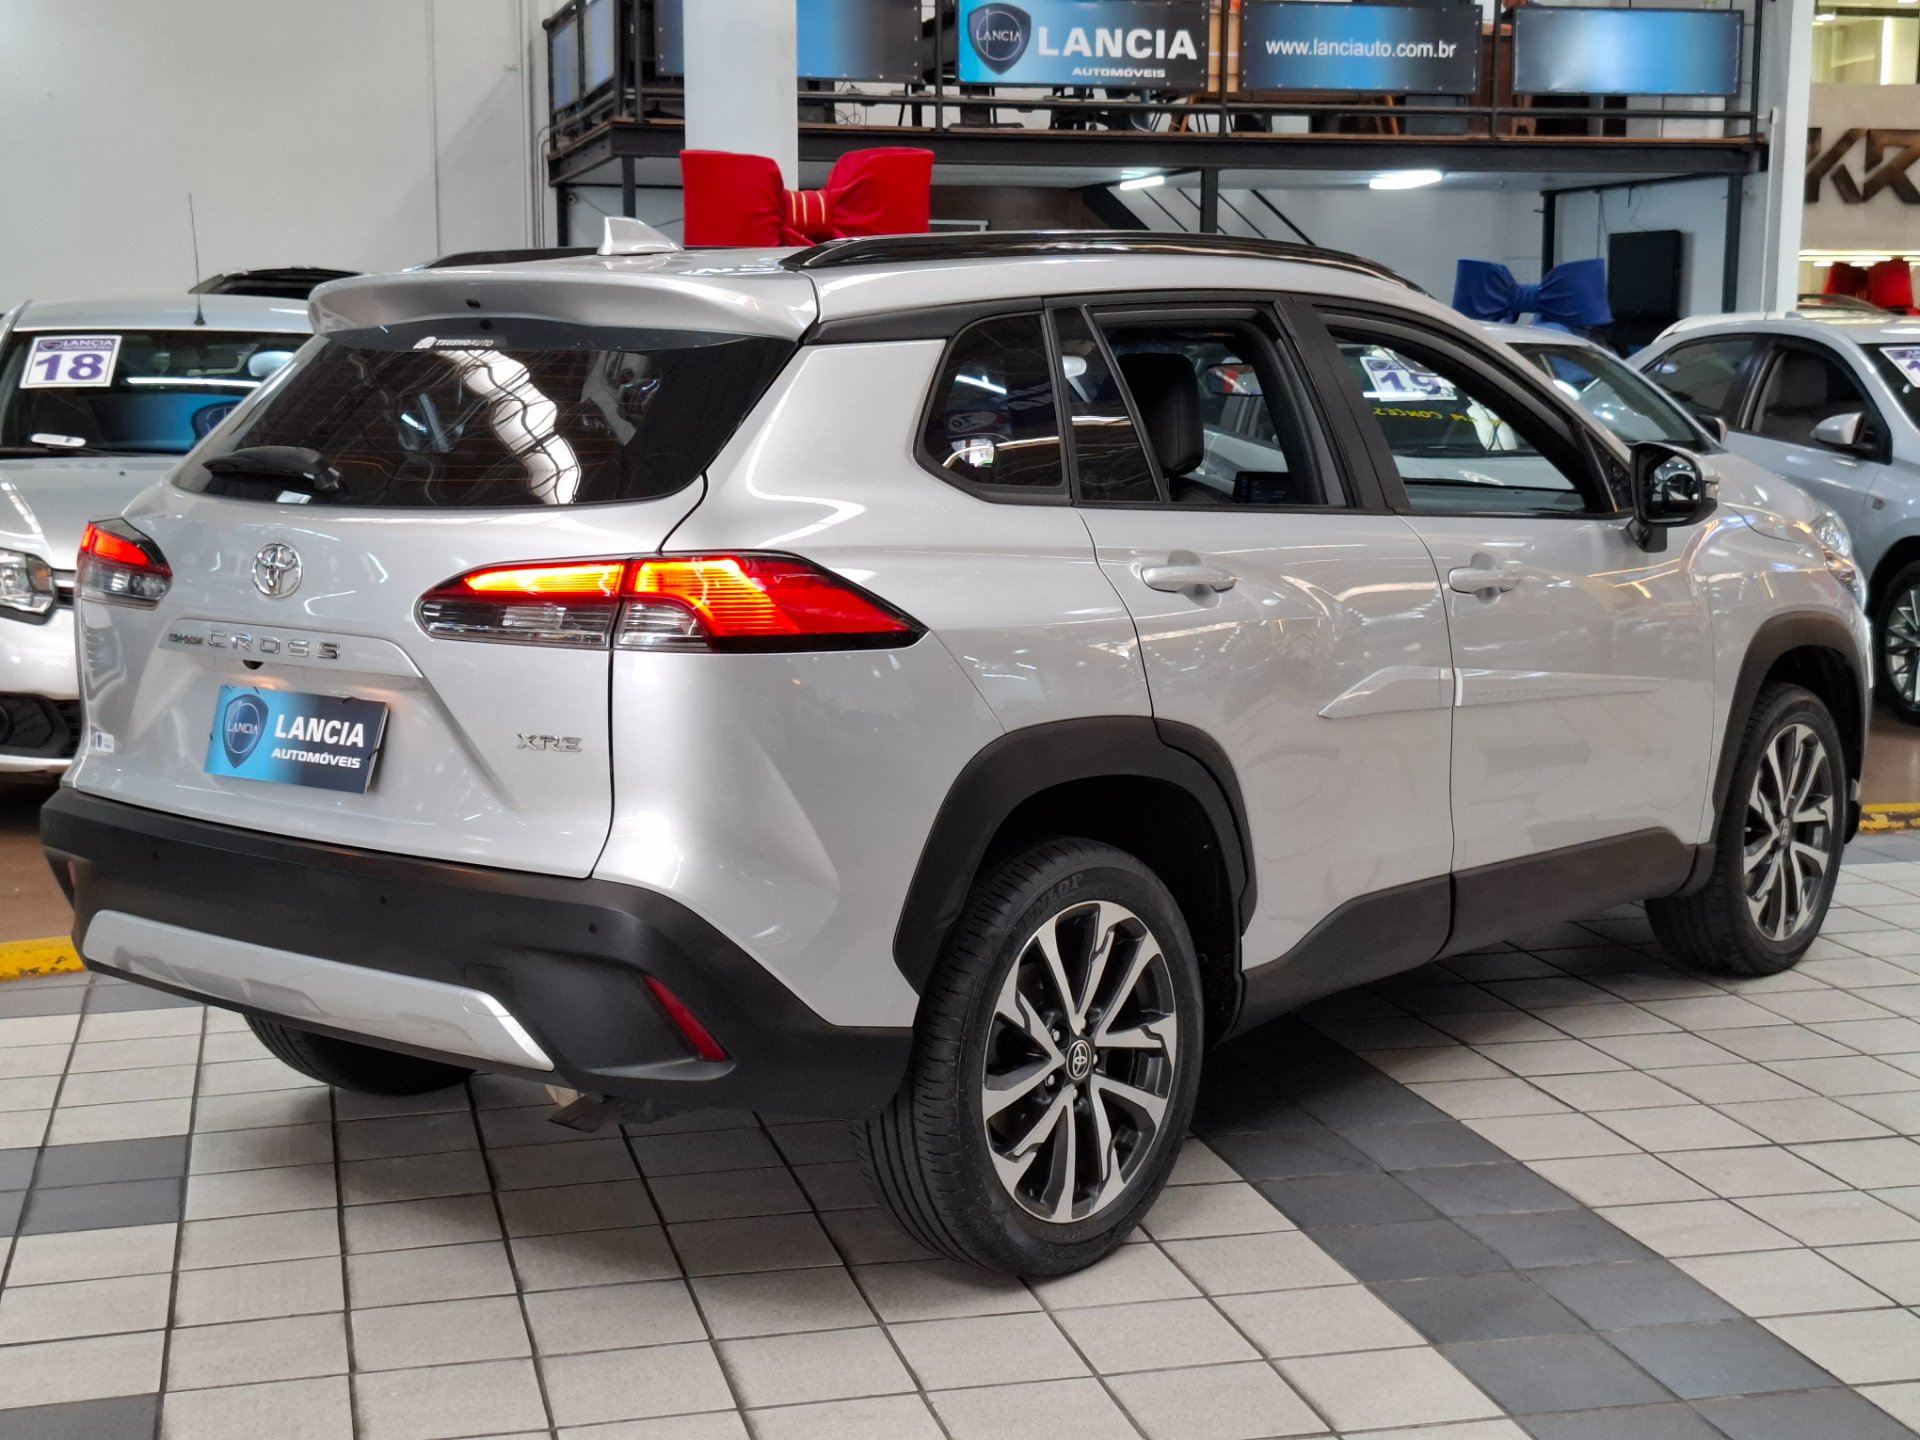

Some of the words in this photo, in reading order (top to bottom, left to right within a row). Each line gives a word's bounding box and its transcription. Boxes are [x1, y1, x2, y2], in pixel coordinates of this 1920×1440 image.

[976, 29, 1023, 42] LANCIA
[1038, 26, 1198, 60] LANCIA
[1266, 37, 1457, 58] www.lanciauto.com.br
[1072, 67, 1166, 78] AUTOMÓVEIS
[35, 353, 104, 381] 18
[208, 630, 341, 660] CROSS
[228, 721, 258, 736] LANCIA
[275, 714, 364, 748] LANCIA
[516, 733, 583, 753] XRE
[271, 747, 361, 769] AUTOMÓVEIS
